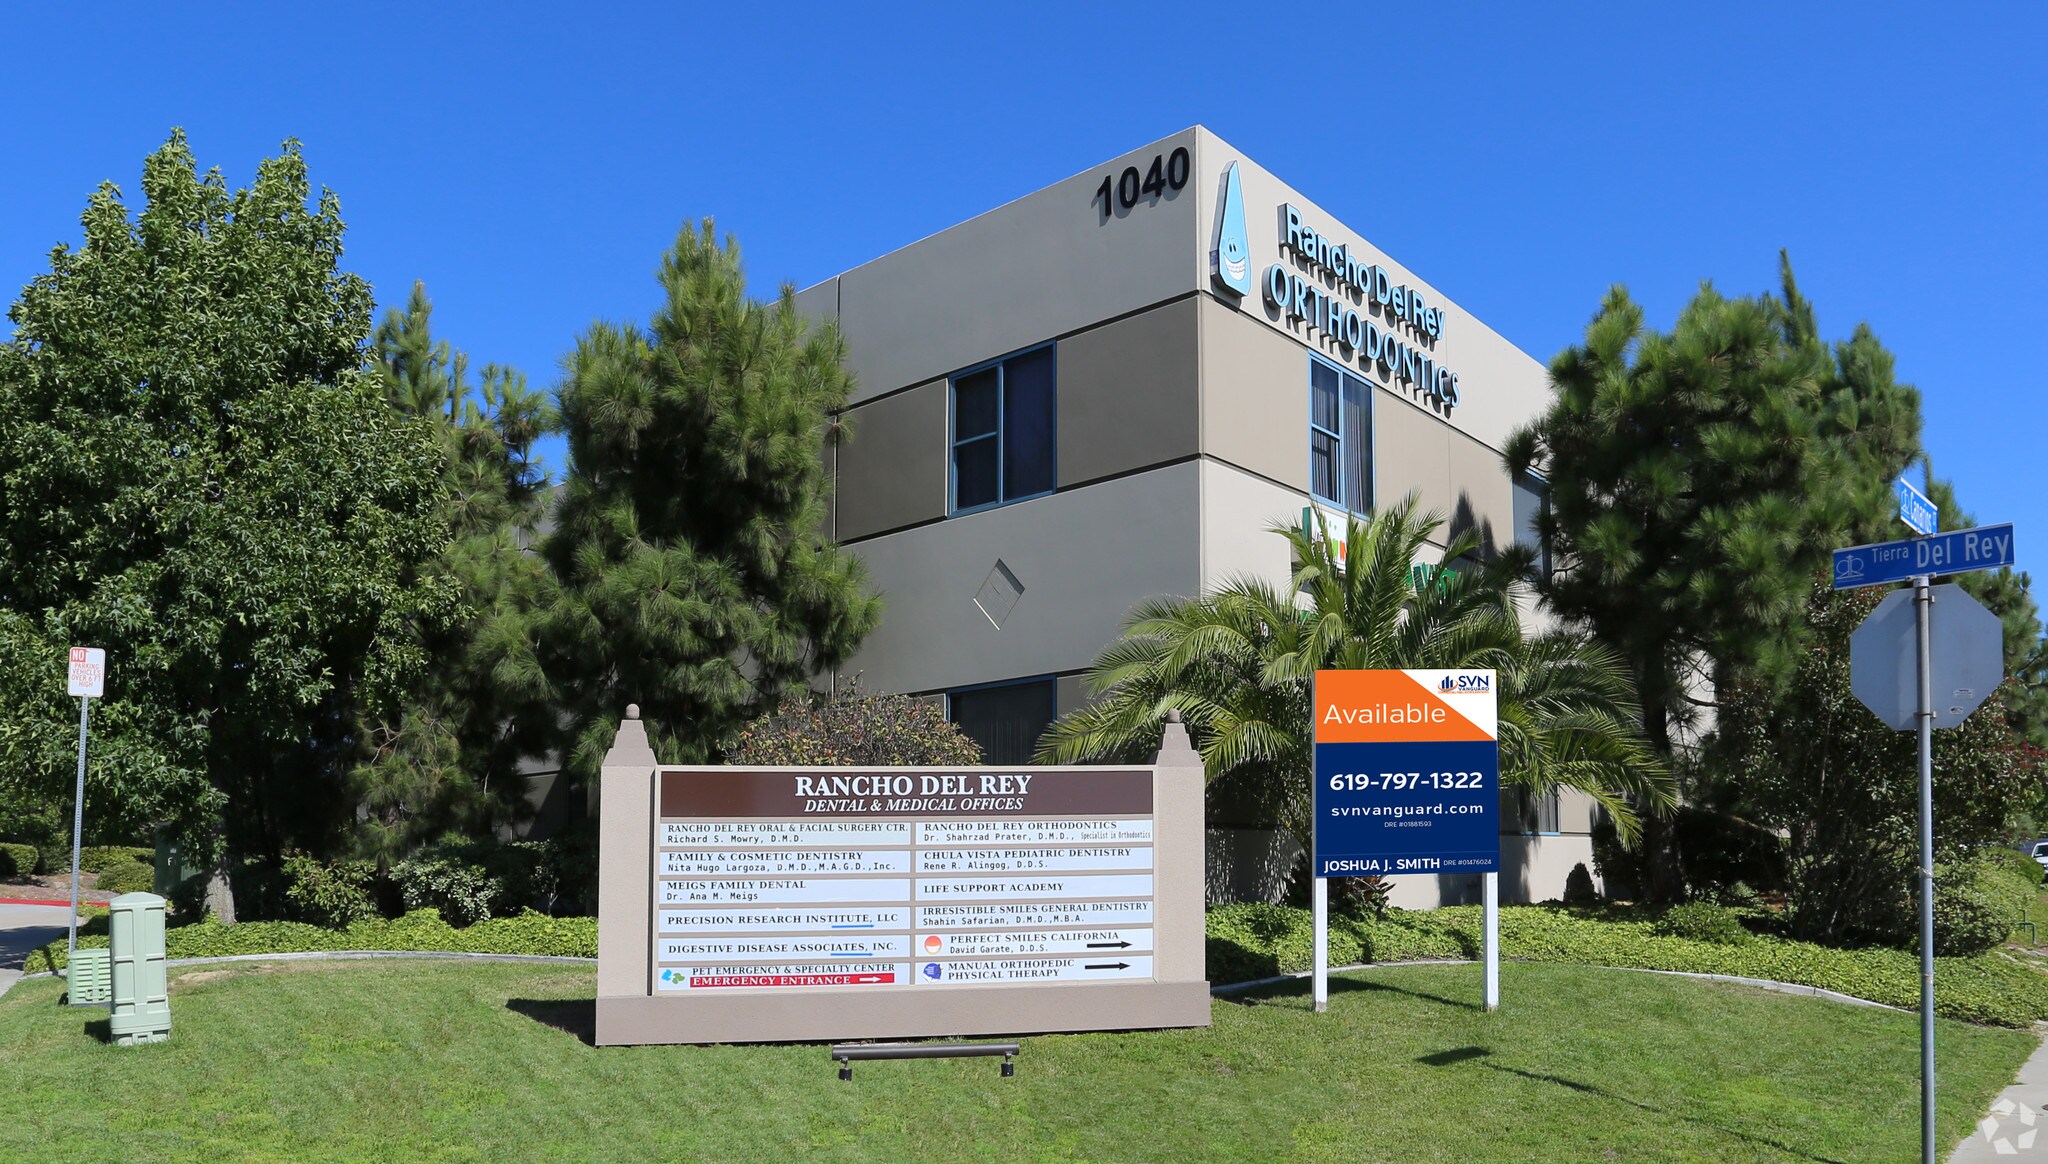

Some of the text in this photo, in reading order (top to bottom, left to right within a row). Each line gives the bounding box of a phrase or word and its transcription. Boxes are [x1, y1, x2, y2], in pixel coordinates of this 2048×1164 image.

[1096, 146, 1191, 217] 1040
[1278, 203, 1445, 341] Rancho Del Rey
[1263, 263, 1461, 408] ORTHODONTICS
[1872, 533, 2010, 568] Tierra Del Rey
[73, 650, 84, 660] NO
[1458, 675, 1489, 687] SVN
[1324, 703, 1446, 724] Available
[795, 776, 1032, 797] RANCHO DEL REY
[1330, 772, 1483, 791] 619-797-1322
[804, 798, 1024, 812] DENTAL & MEDICAL OFFICES
[1332, 803, 1483, 818] svnvanguard.com
[737, 824, 756, 832] REY
[759, 824, 785, 832] ORAL
[788, 824, 796, 832] &
[799, 824, 834, 832] FACIAL
[837, 824, 883, 832] SURGERY
[925, 823, 973, 831] RANCHO
[977, 823, 1000, 831] DEL
[1028, 821, 1117, 830] ORTHODONTICS
[668, 835, 803, 844] Richard S. Mowry, D.M.D.
[946, 833, 990, 841] Shahrzad
[996, 833, 1032, 842] Prater,
[1038, 833, 1074, 841] D.M.D.,
[1081, 832, 1108, 842] Specialist
[1118, 830, 1151, 839] Orthodontics
[669, 852, 863, 861] FAMILY & COSMETIC DENTISTRY
[968, 851, 999, 859] VISTA
[1005, 850, 1065, 858] PEDIATRIC
[1069, 849, 1131, 857] DENTISTRY
[668, 864, 691, 872] Nita
[697, 864, 720, 873] Hugo
[726, 863, 770, 873] Largoza,
[924, 862, 945, 870] Rene
[968, 861, 1010, 871] Alingog,
[1324, 858, 1440, 873] JOSHUA J. SMITH
[667, 882, 706, 890] MEIGS
[759, 881, 806, 889] DENTAL
[953, 884, 1005, 893] SUPPORT
[1010, 883, 1064, 891] ACADEMY
[667, 892, 758, 901] Dr. Ana M. Meigs
[923, 903, 1148, 915] IRRESISTIBLE SMILES GENERAL DENTISTRY
[668, 914, 898, 925] PRECISION RESEARCH INSTITUTE, LLC
[923, 918, 956, 926] Shahin
[962, 917, 1009, 926] Safarian,
[950, 932, 1119, 944] PERFECT SMILES CALIFORNIA
[669, 943, 896, 953] DIGESTIVE DISEASE ASSOCIATES, INC.
[950, 944, 1048, 954] David Garate, D.D.S.
[716, 966, 781, 975] EMERGENCY
[796, 965, 850, 973] SPECIALTY
[854, 964, 895, 972] CENTER
[948, 960, 1074, 970] MANUAL ORTHOPEDIC
[948, 969, 1060, 980] PHYSICAL THERAPY
[693, 976, 850, 986] EMERGENCY ENTRANCE
